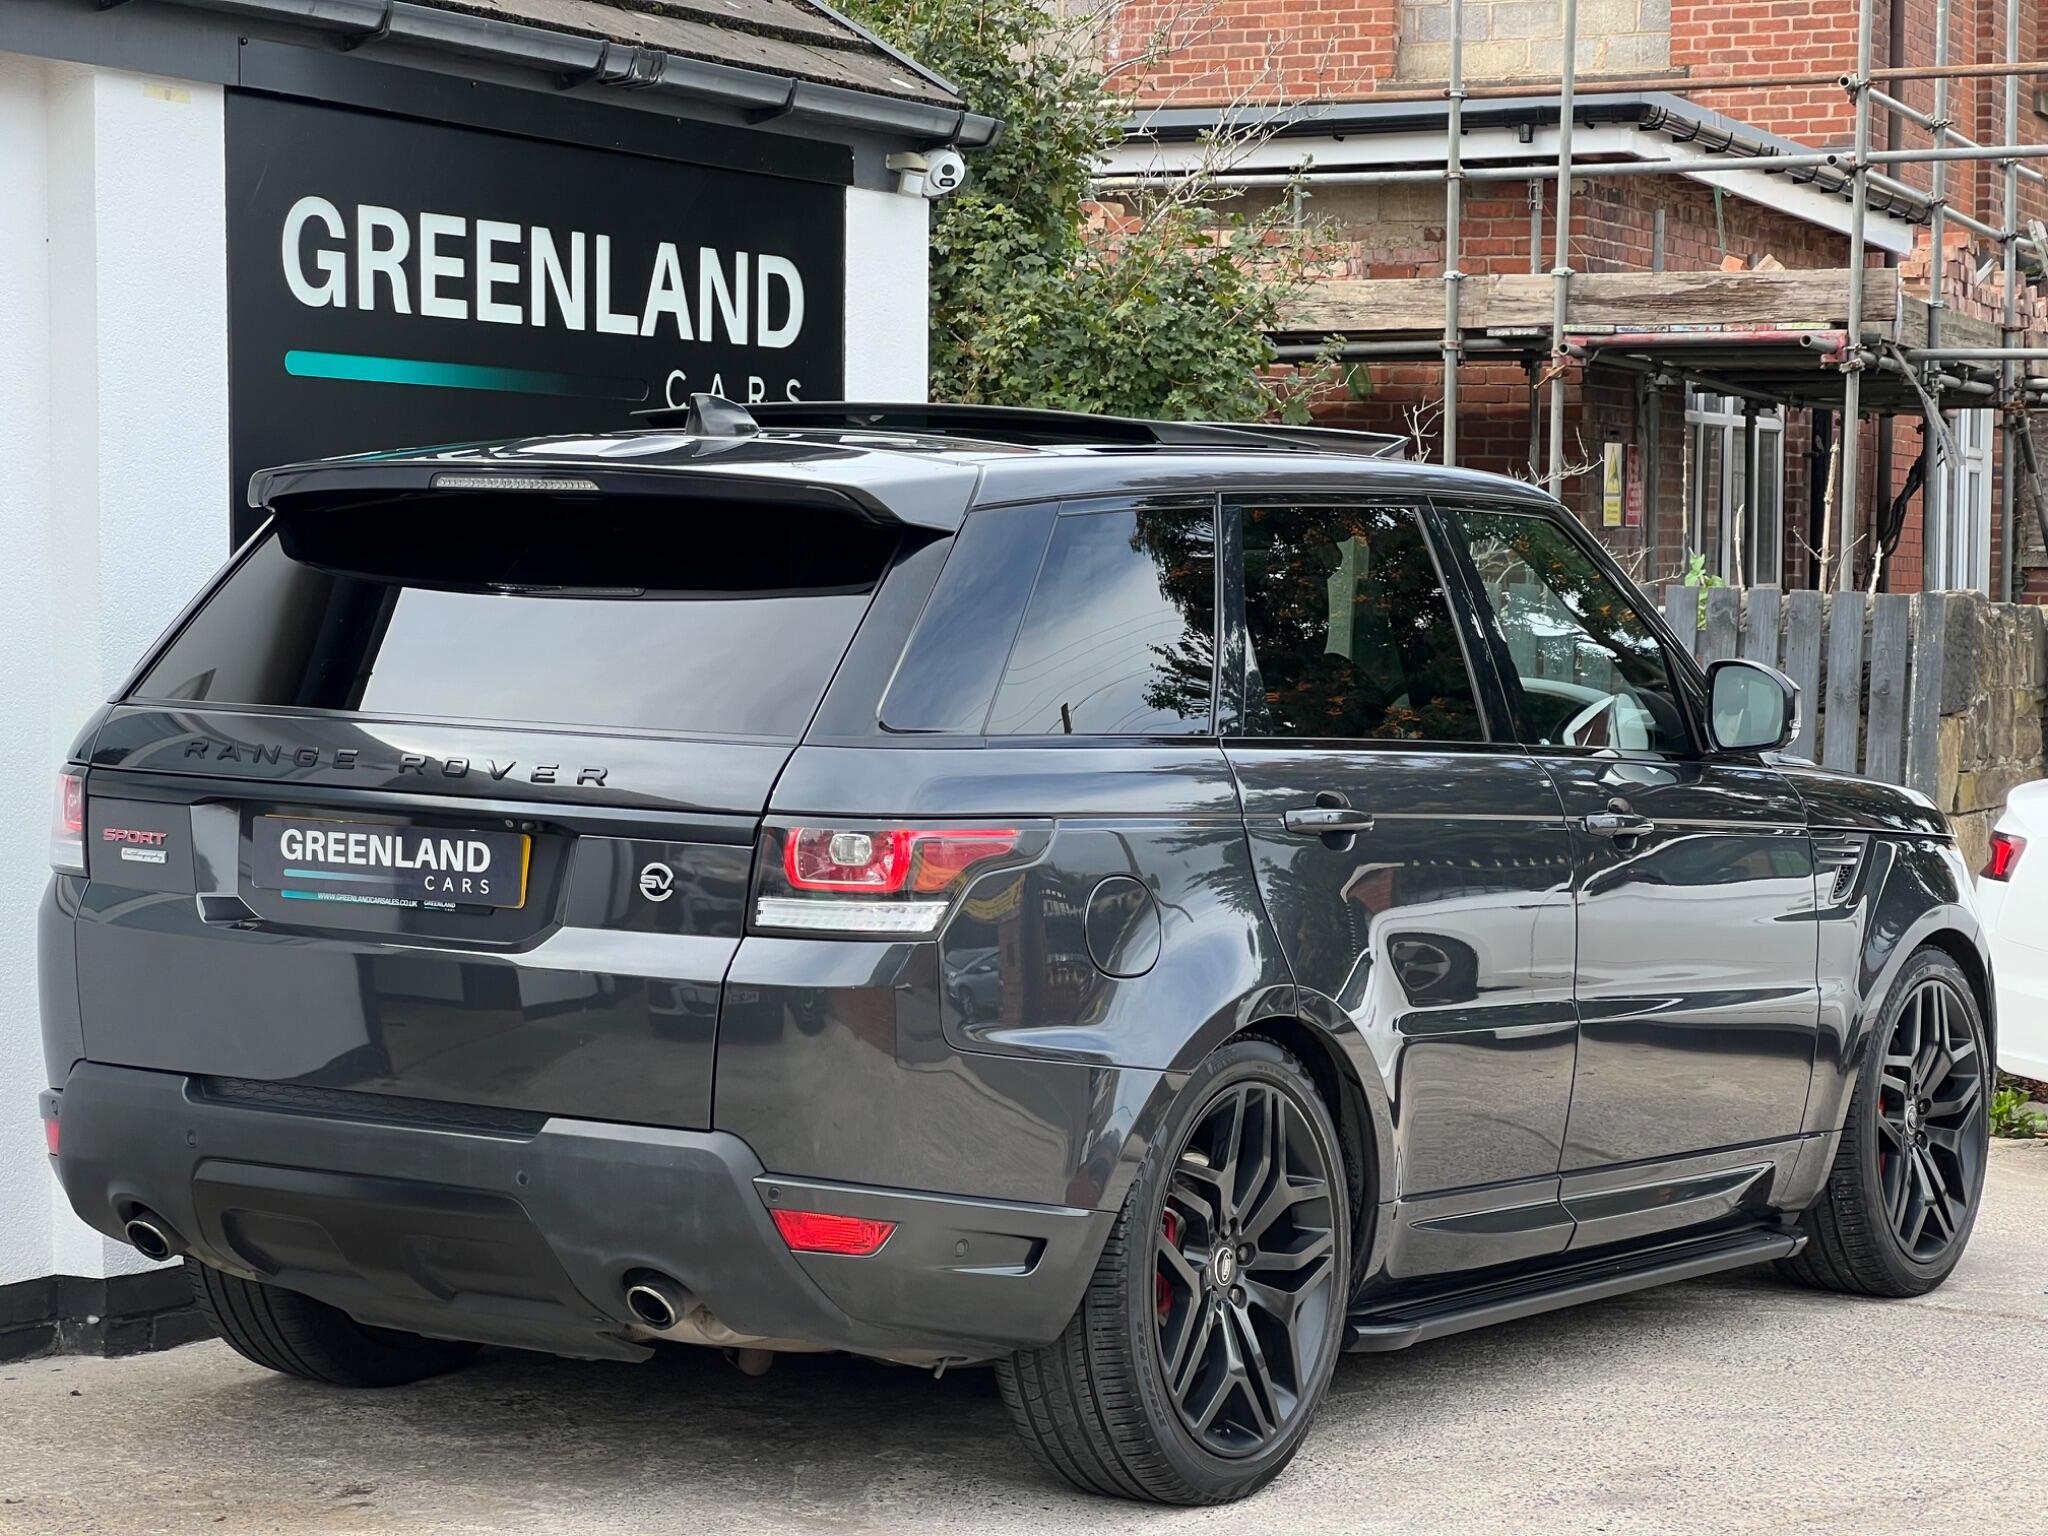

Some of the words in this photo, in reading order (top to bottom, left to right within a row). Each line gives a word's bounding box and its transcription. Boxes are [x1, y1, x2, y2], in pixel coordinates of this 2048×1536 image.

[282, 196, 804, 348] GREENLAND
[184, 739, 359, 770] RANGE
[398, 753, 609, 787] ROVER
[103, 828, 167, 845] SPORT
[280, 828, 492, 873] GREENLAND
[424, 875, 490, 894] CARS
